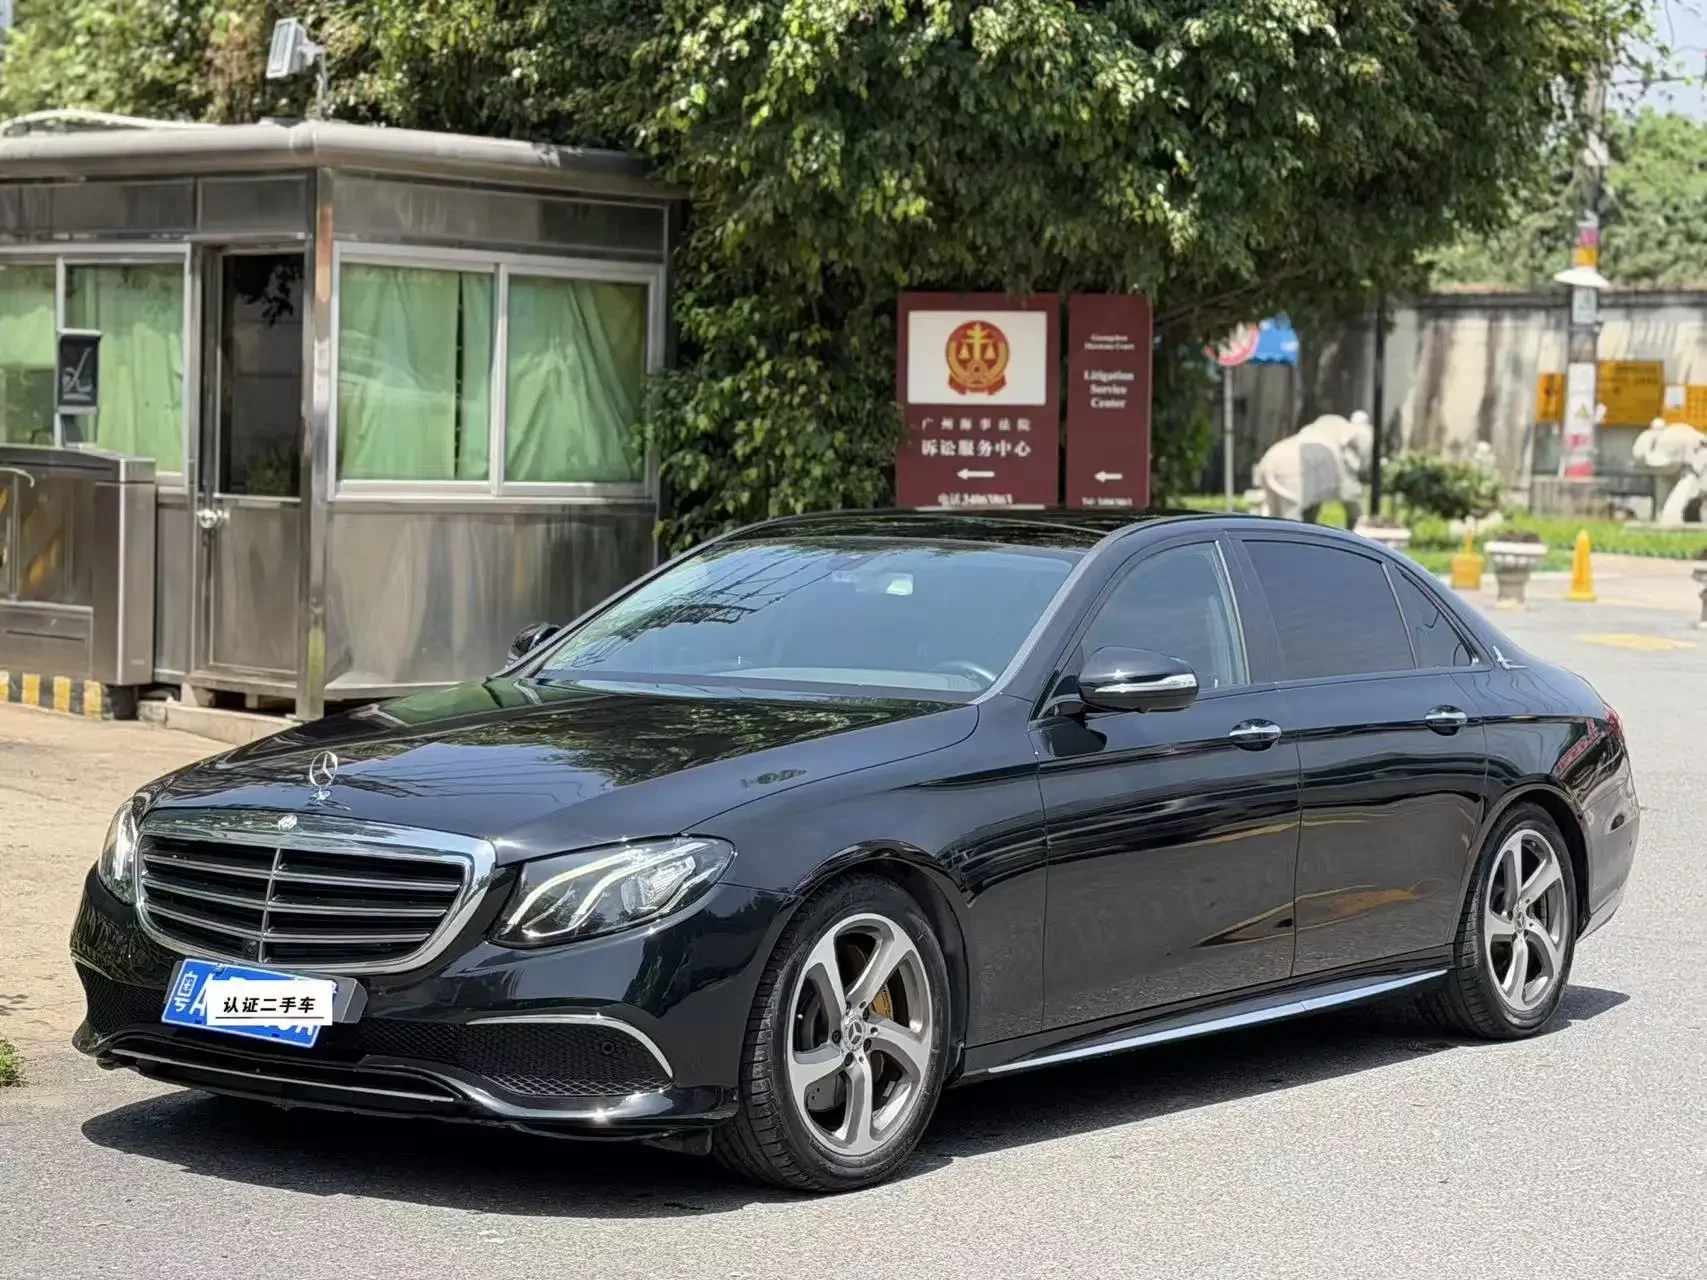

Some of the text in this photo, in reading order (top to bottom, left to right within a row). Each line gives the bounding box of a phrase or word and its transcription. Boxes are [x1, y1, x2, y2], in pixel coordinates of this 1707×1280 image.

[1084, 369, 1135, 382] Litigation
[1090, 383, 1128, 395] Service
[1090, 397, 1126, 408] Center
[921, 438, 1032, 457] 诉讼服务中心
